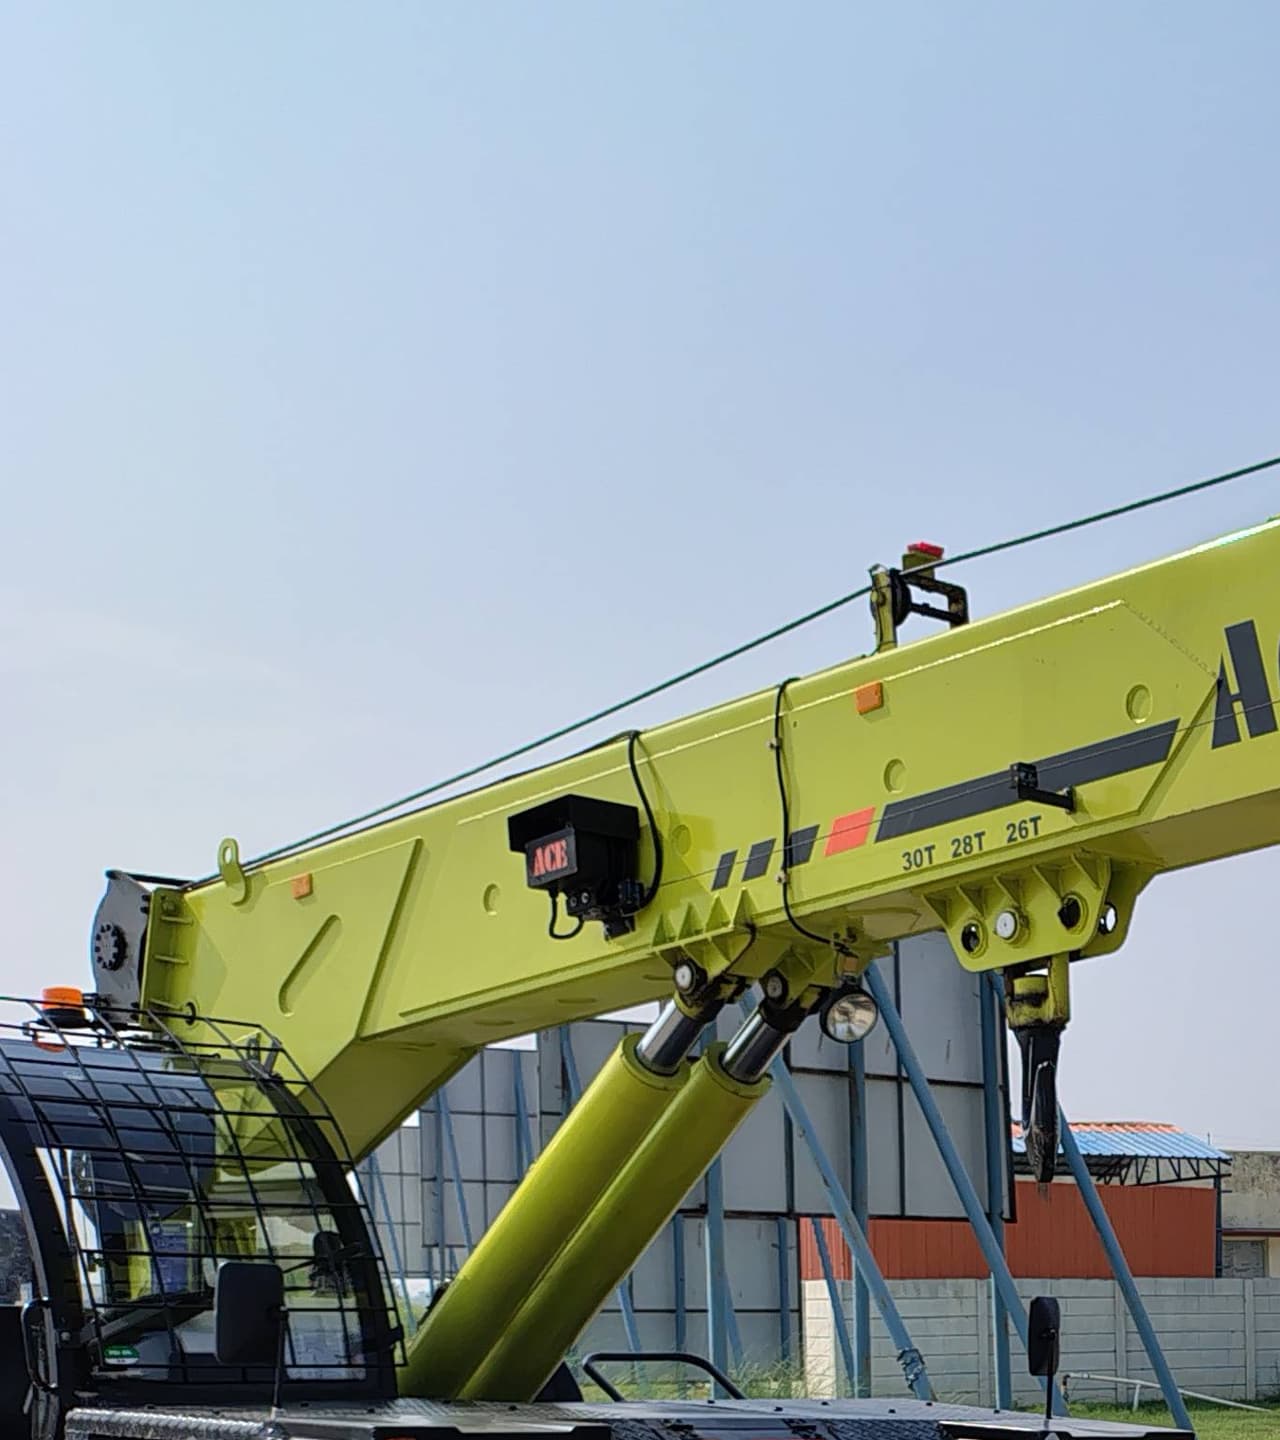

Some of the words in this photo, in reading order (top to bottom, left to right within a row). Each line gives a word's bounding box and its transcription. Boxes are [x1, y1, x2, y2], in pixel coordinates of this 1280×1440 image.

[532, 839, 567, 876] ACE
[901, 845, 936, 871] 30T
[951, 831, 985, 858] 28T
[1006, 815, 1042, 843] 26T
